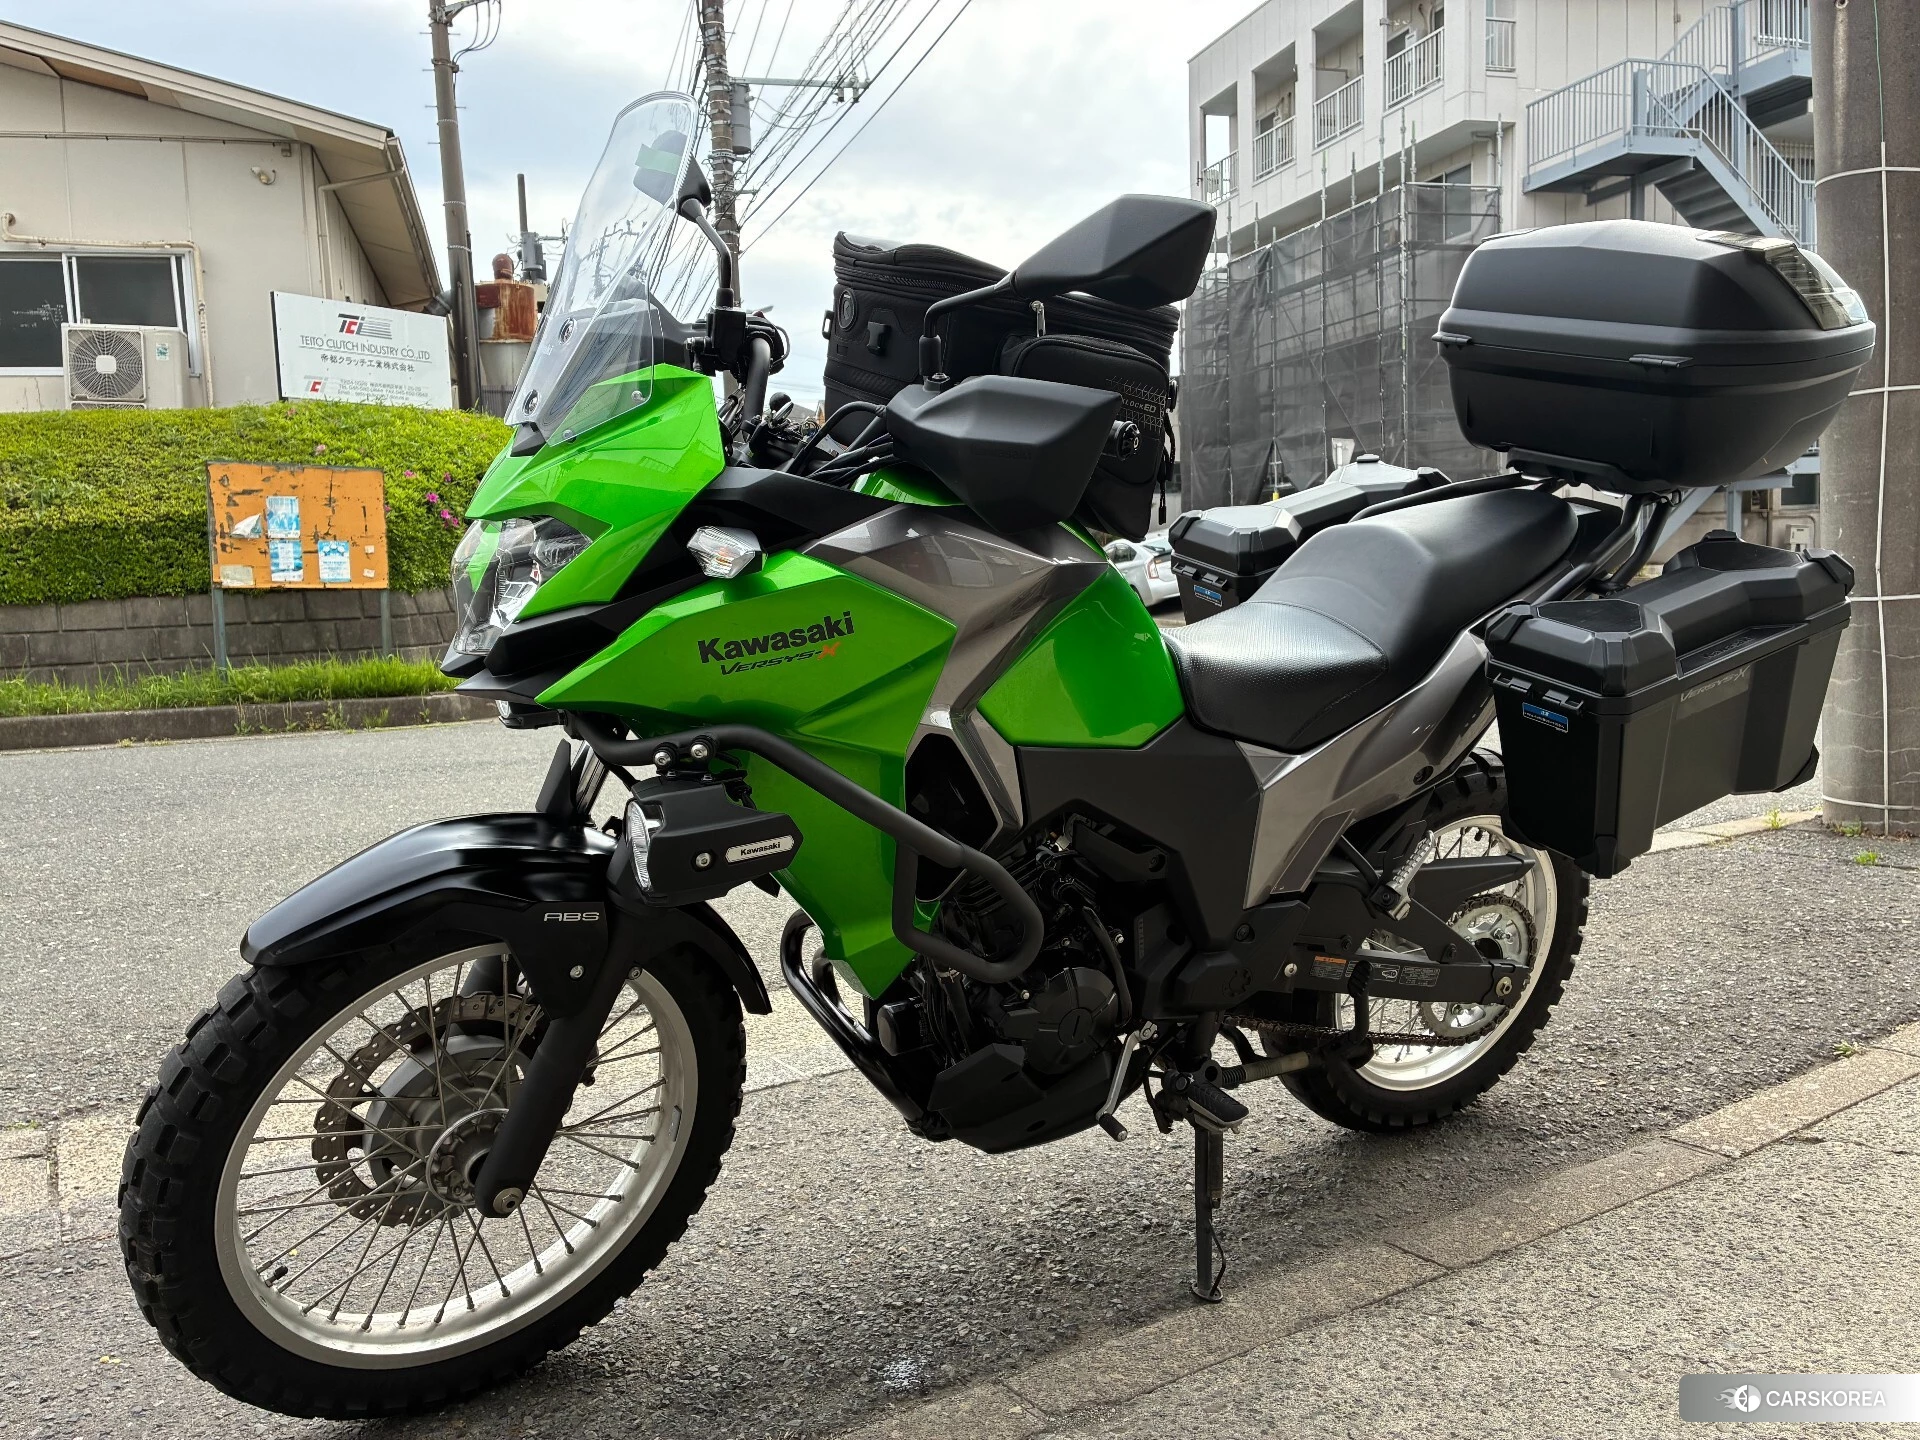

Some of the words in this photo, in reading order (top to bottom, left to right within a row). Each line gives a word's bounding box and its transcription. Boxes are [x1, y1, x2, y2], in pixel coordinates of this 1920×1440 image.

[326, 338, 358, 351] CLUTCH
[360, 343, 398, 356] INDUSTRY
[697, 611, 855, 663] Kawasaki
[720, 641, 841, 676] VERSYS-X
[740, 841, 781, 857] Kawasaki
[543, 911, 600, 922] ABS
